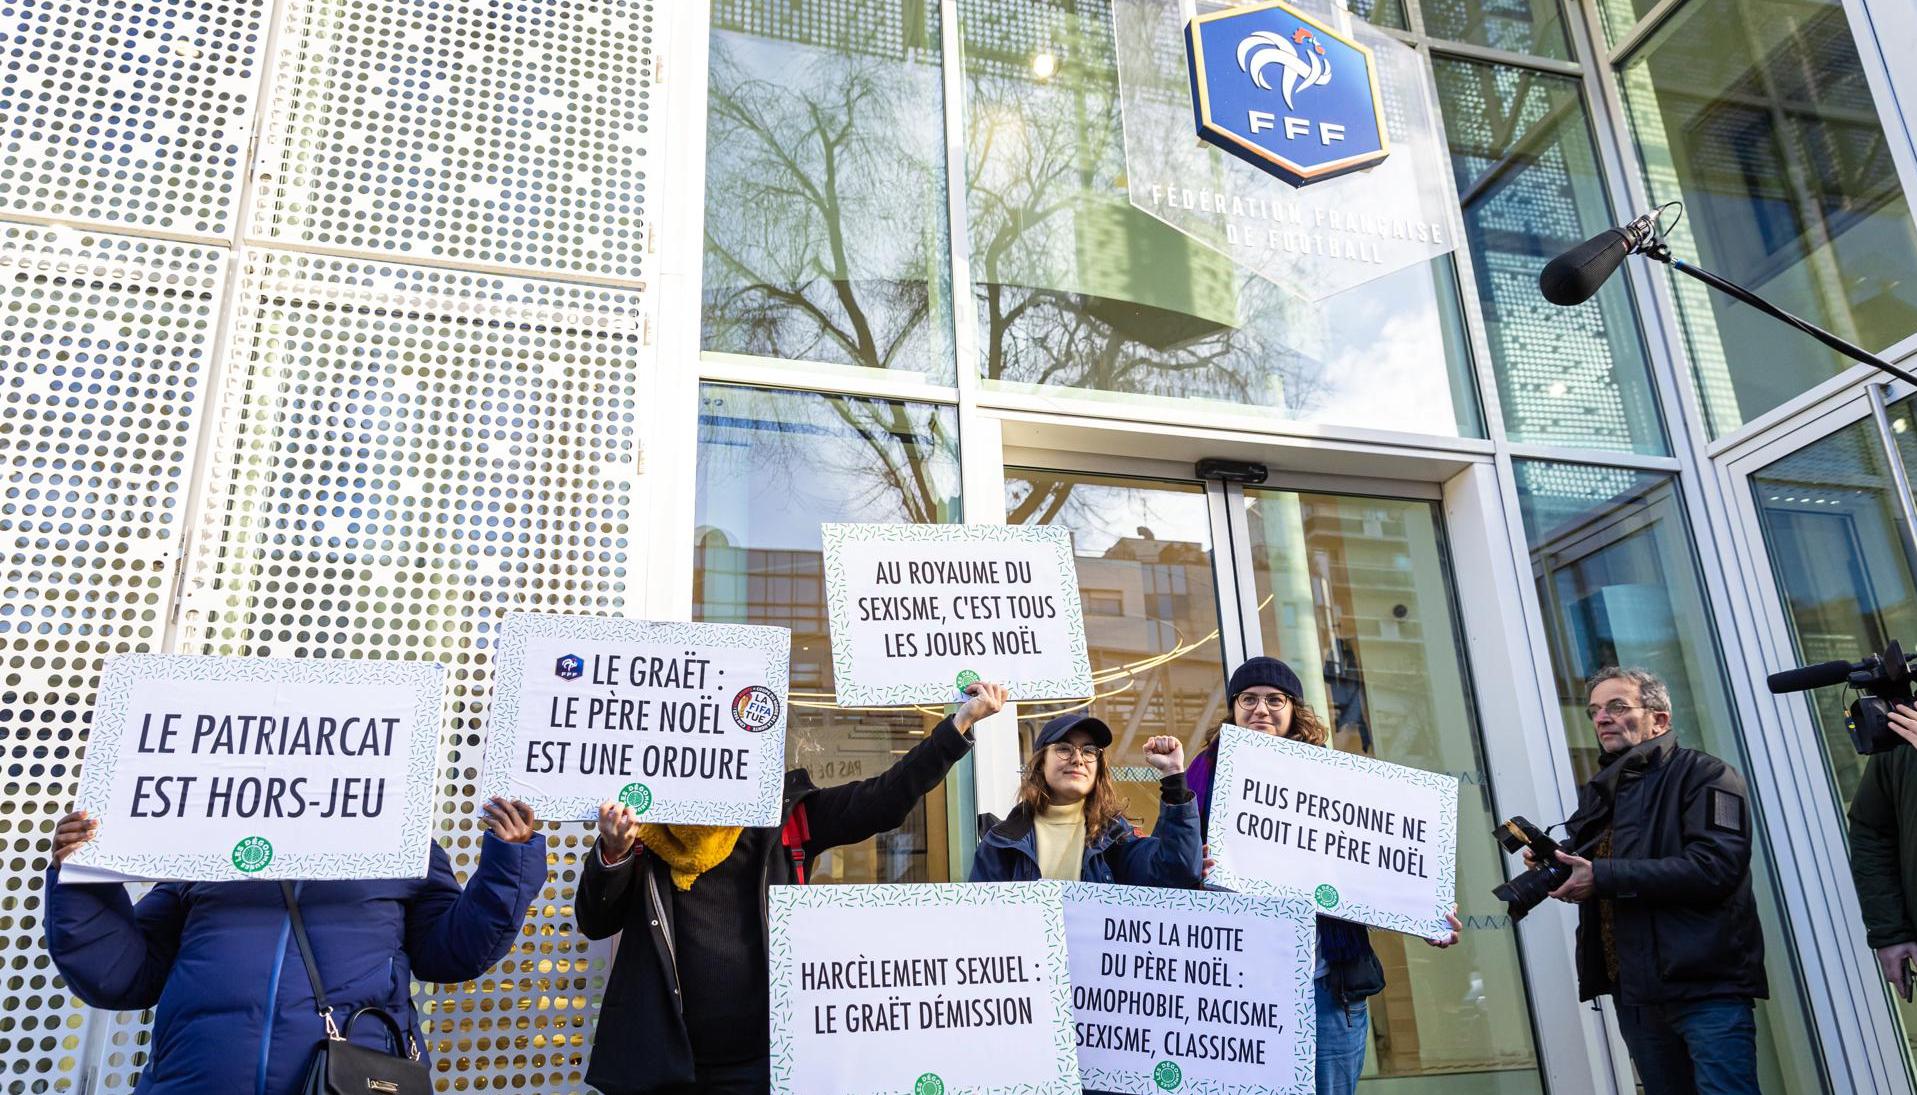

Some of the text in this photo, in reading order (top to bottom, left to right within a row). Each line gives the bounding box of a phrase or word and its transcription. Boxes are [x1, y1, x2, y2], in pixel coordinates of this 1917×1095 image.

[1248, 110, 1345, 146] FFF
[1151, 183, 1443, 245] FÉDÉRATION FRANÇAISE
[1226, 225, 1384, 265] DE FOOTBALL
[876, 561, 1032, 585] AU ROYAUME DU
[858, 595, 1056, 625] SEXISME, C'EST TOUS
[884, 625, 1042, 658] LES JOURS NOËL
[592, 654, 621, 686] LE
[629, 650, 711, 690] GRAËT
[550, 689, 725, 735] LE PÈRE NOËL
[745, 710, 766, 724] TUE
[749, 702, 771, 717] FIFA
[755, 694, 767, 705] LA
[137, 713, 401, 757] LE PATRIARCAT
[525, 740, 572, 774] EST
[579, 742, 634, 776] UNE
[642, 744, 750, 781] ORDURE
[130, 775, 385, 819] EST HORS-JEU
[1242, 778, 1427, 844] PLUS PERSONNE NE
[1236, 811, 1428, 879] CROIT LE PÈRE NOËL
[1104, 917, 1244, 953] DANS LA HOTTE
[801, 954, 949, 991] HARCÈLEMENT
[955, 955, 1029, 985] SEXUEL
[1101, 952, 1127, 978] DU
[1133, 950, 1178, 983] PÈRE
[1184, 956, 1232, 988] NOËL
[814, 993, 1033, 1035] LE GRAËT DÉMISSION
[1070, 985, 1284, 1035] OMOPHOBIE, RACISME,
[1075, 1021, 1266, 1065] SEXISME, CLASSISME
